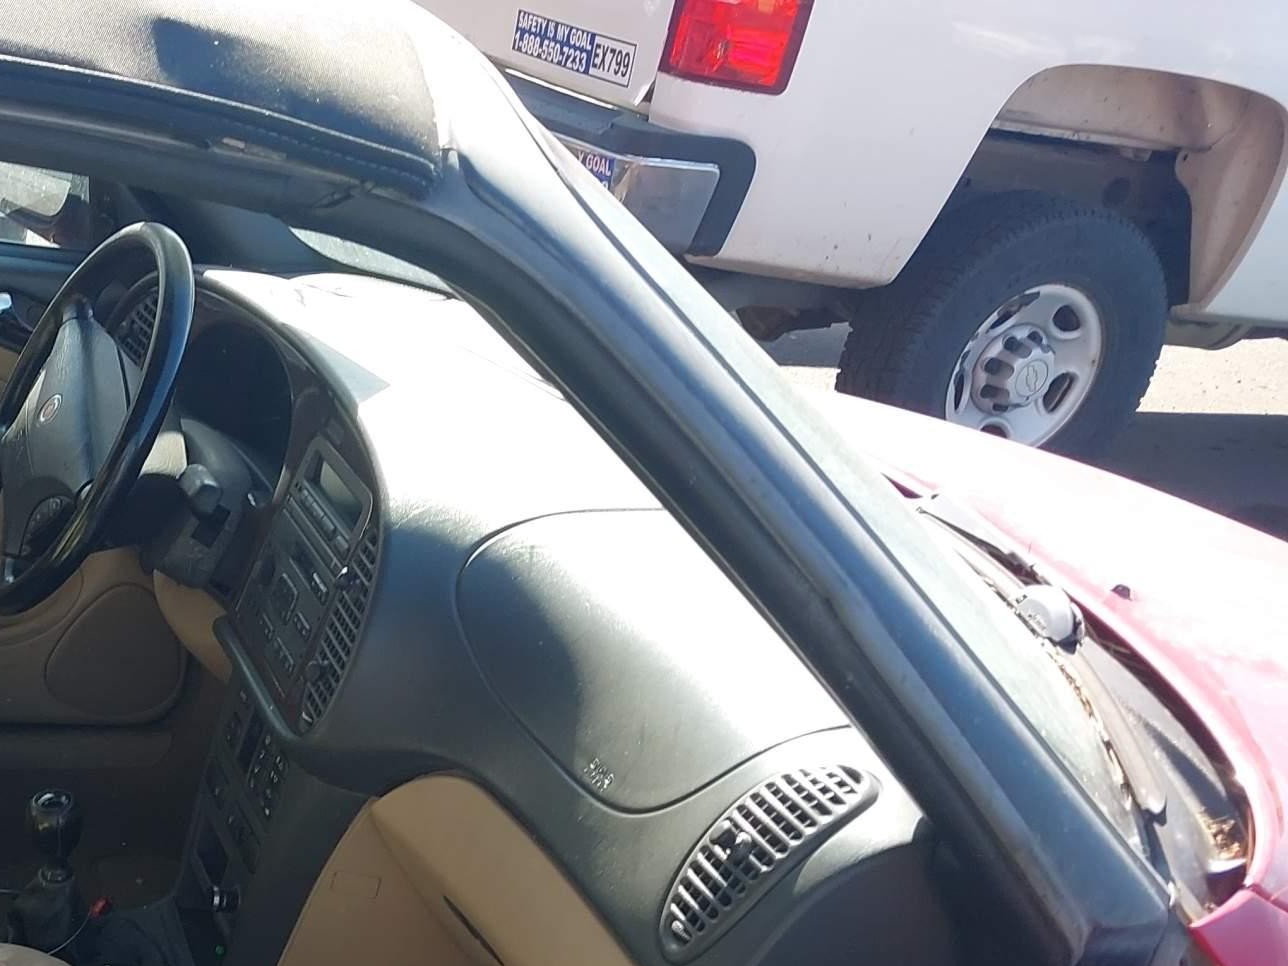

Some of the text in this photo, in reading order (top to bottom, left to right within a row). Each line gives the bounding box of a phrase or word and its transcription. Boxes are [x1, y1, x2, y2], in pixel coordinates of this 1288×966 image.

[518, 11, 592, 50] SAFETY IS MY GOAL
[514, 30, 587, 73] 1-888-550-7233
[592, 43, 631, 78] EX799
[586, 153, 611, 177] GOAL
